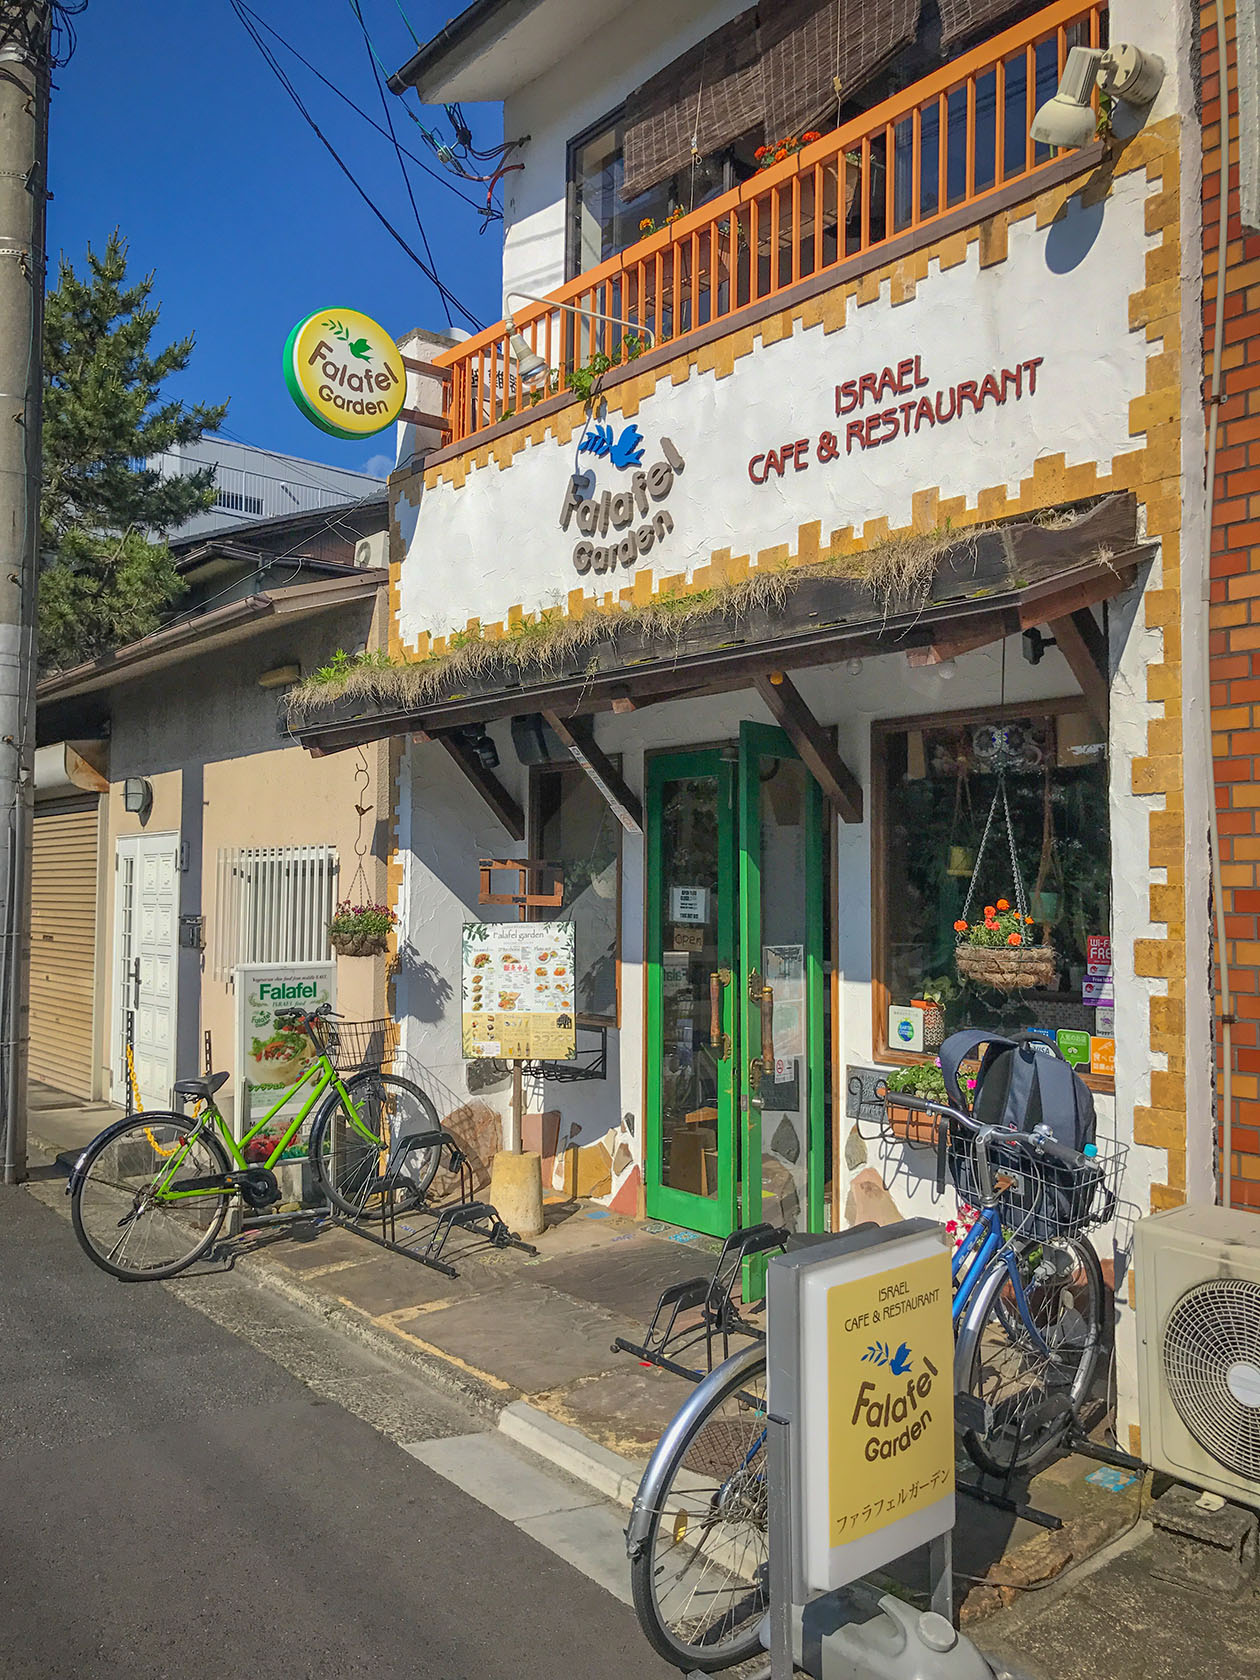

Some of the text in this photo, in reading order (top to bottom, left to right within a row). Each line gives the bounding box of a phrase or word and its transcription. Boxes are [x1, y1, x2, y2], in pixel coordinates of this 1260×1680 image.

[308, 340, 399, 393] Falafel
[835, 355, 929, 416] ISRAEL
[318, 385, 389, 415] Garden
[748, 357, 1043, 485] CAFE & RESTAURANT
[559, 436, 685, 538] Falafel
[573, 510, 674, 575] Garden
[518, 930, 545, 941] garden
[675, 934, 702, 946] Open
[1090, 938, 1111, 947] Wi-F
[260, 981, 317, 1000] Falafel
[844, 1288, 939, 1332] CAFE & RESTAURANT
[878, 1281, 909, 1302] ISRAEL
[852, 1356, 939, 1428] Falafel
[865, 1409, 932, 1462] Garden
[836, 1468, 950, 1535] ファラフェルガーデン
